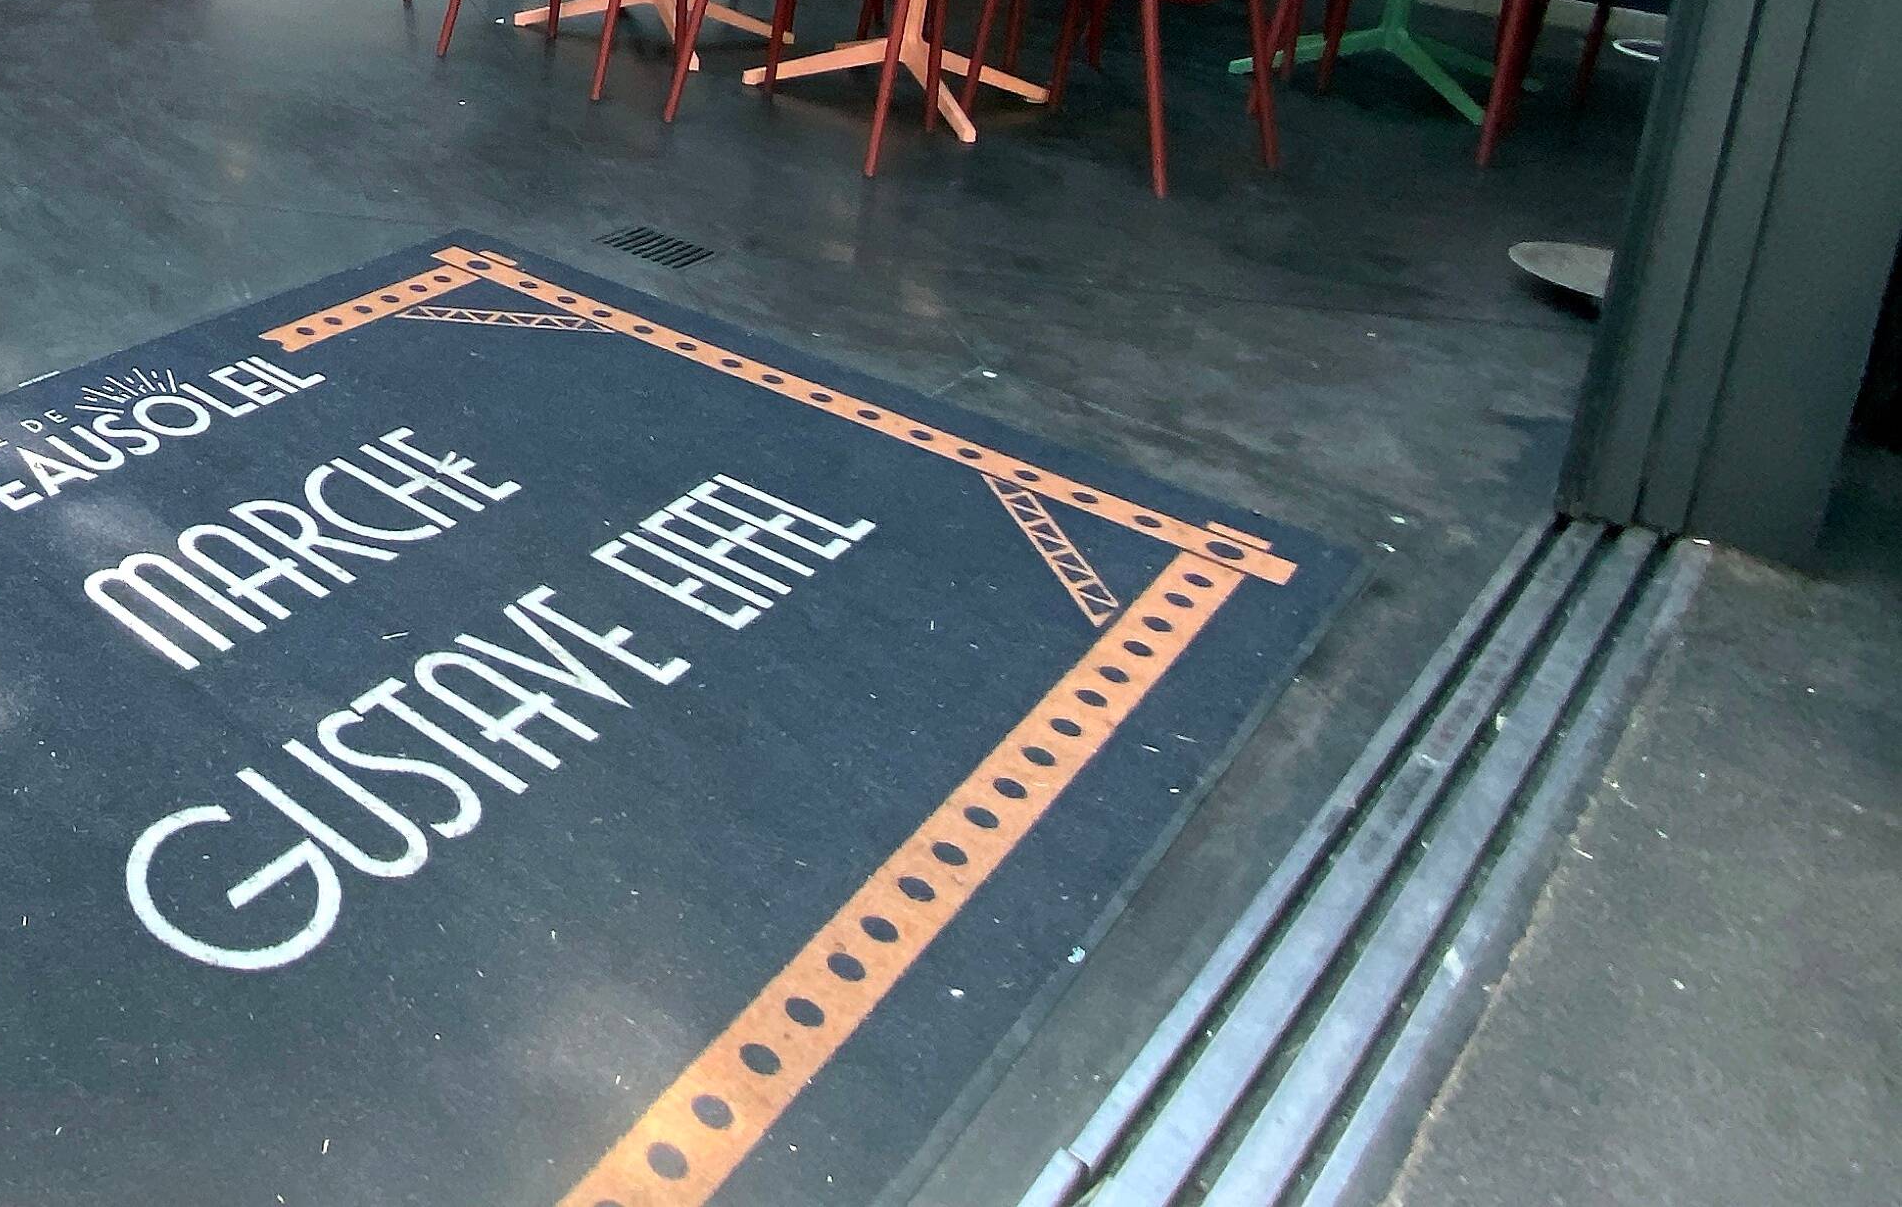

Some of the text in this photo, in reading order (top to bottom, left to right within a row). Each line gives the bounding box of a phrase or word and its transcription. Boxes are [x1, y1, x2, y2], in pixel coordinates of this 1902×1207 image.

[20, 409, 68, 434] DE
[126, 473, 876, 970] GUSTAVE EIFFEL
